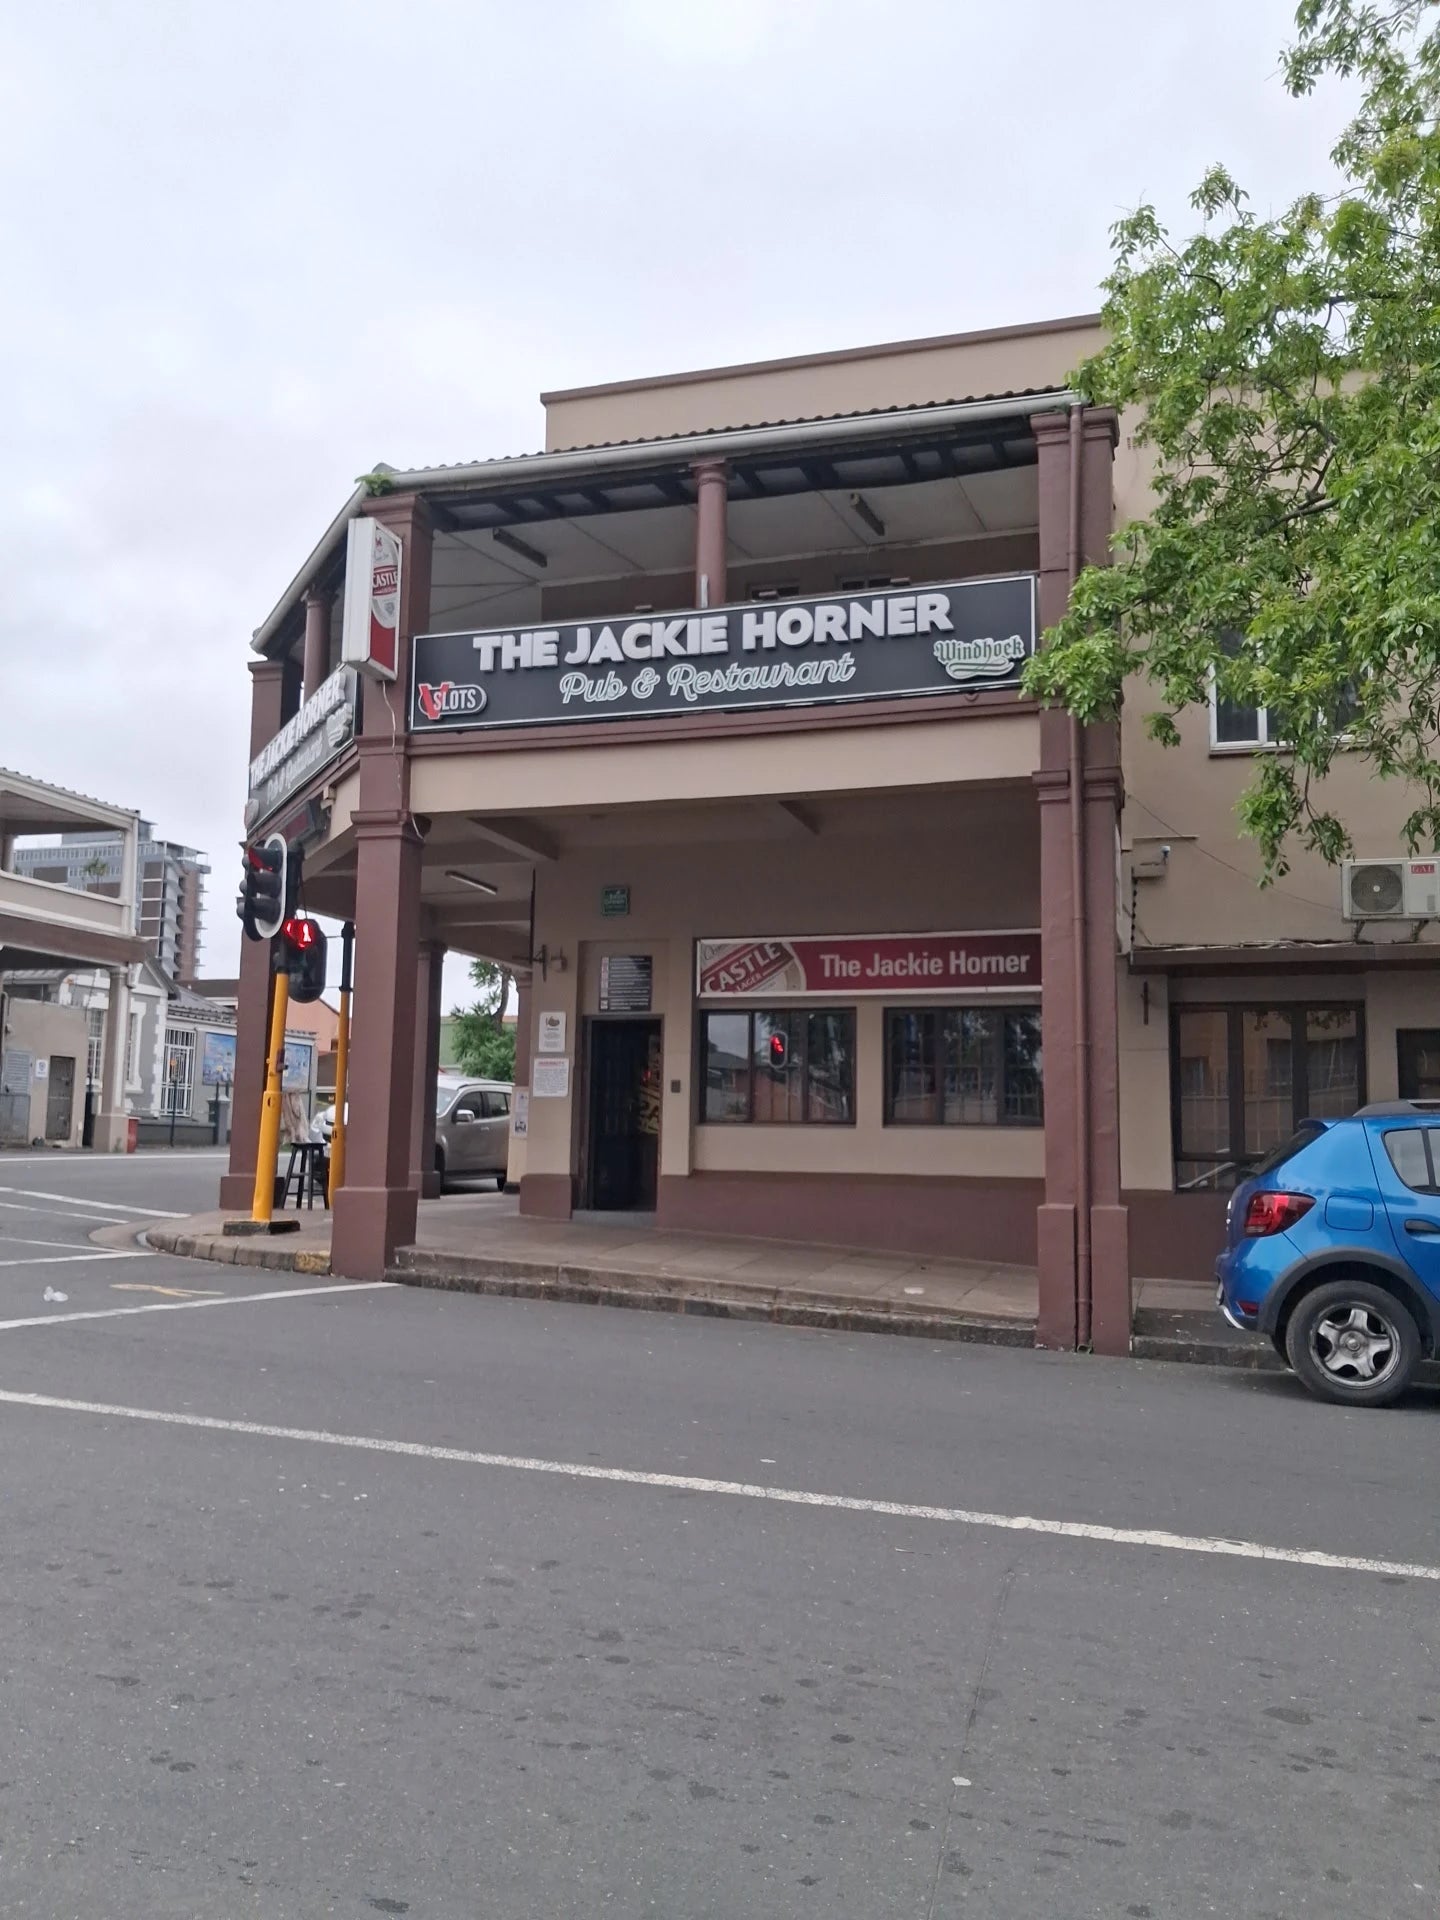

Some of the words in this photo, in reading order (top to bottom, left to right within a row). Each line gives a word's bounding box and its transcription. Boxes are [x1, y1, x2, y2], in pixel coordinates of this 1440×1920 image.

[372, 571, 397, 587] CASTLE
[473, 630, 560, 672] THE
[564, 616, 729, 665] JACKIE
[742, 594, 954, 650] HORNER
[933, 635, 1025, 664] Windhoek
[559, 671, 627, 704] Pub
[631, 667, 660, 699] &
[667, 652, 856, 702] Restaurant
[294, 670, 343, 743] HORNER
[704, 942, 781, 993] CASTLE
[736, 972, 763, 992] LAGER
[820, 954, 861, 978] The
[866, 952, 943, 977] Jackie
[950, 950, 1030, 975] Horner
